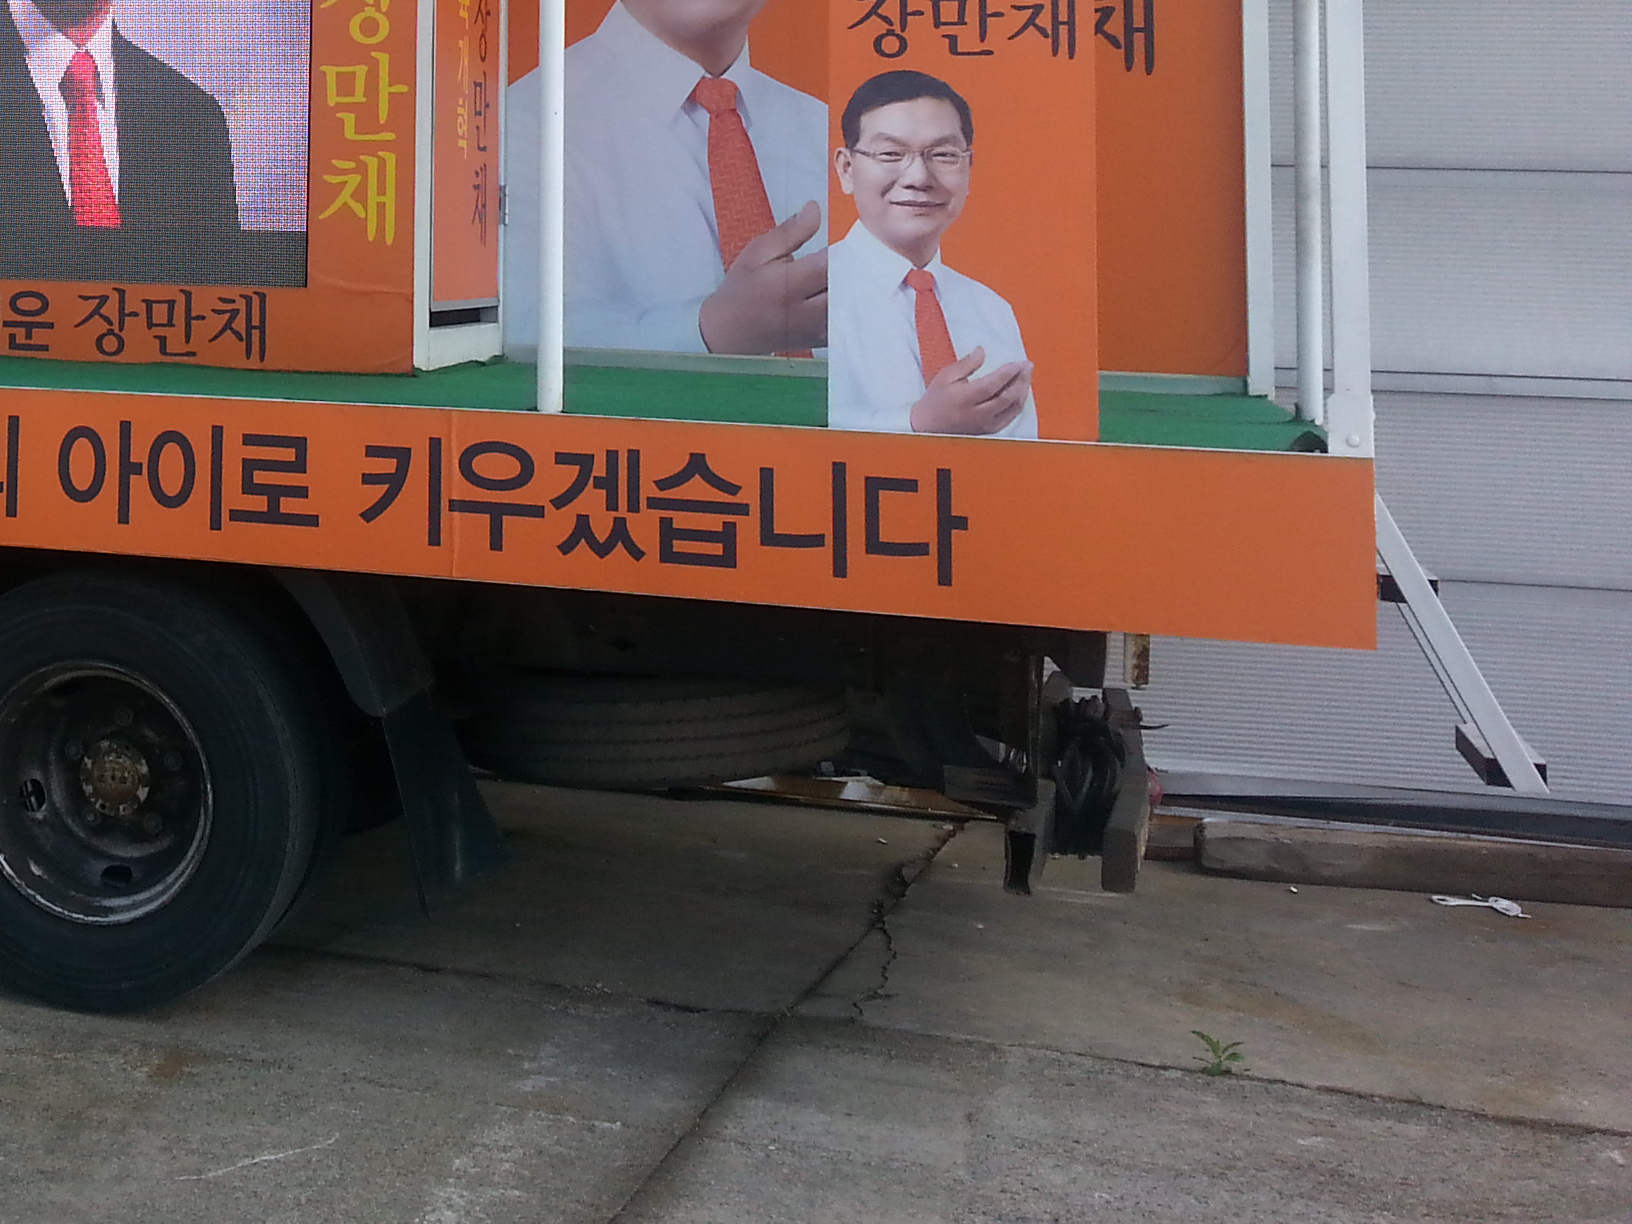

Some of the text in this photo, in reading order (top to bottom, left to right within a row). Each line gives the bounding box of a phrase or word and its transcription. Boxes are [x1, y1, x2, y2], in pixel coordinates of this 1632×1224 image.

[73, 286, 268, 363] 장만채
[57, 420, 321, 532] 아이로
[359, 435, 970, 587] 키우겠습니다
